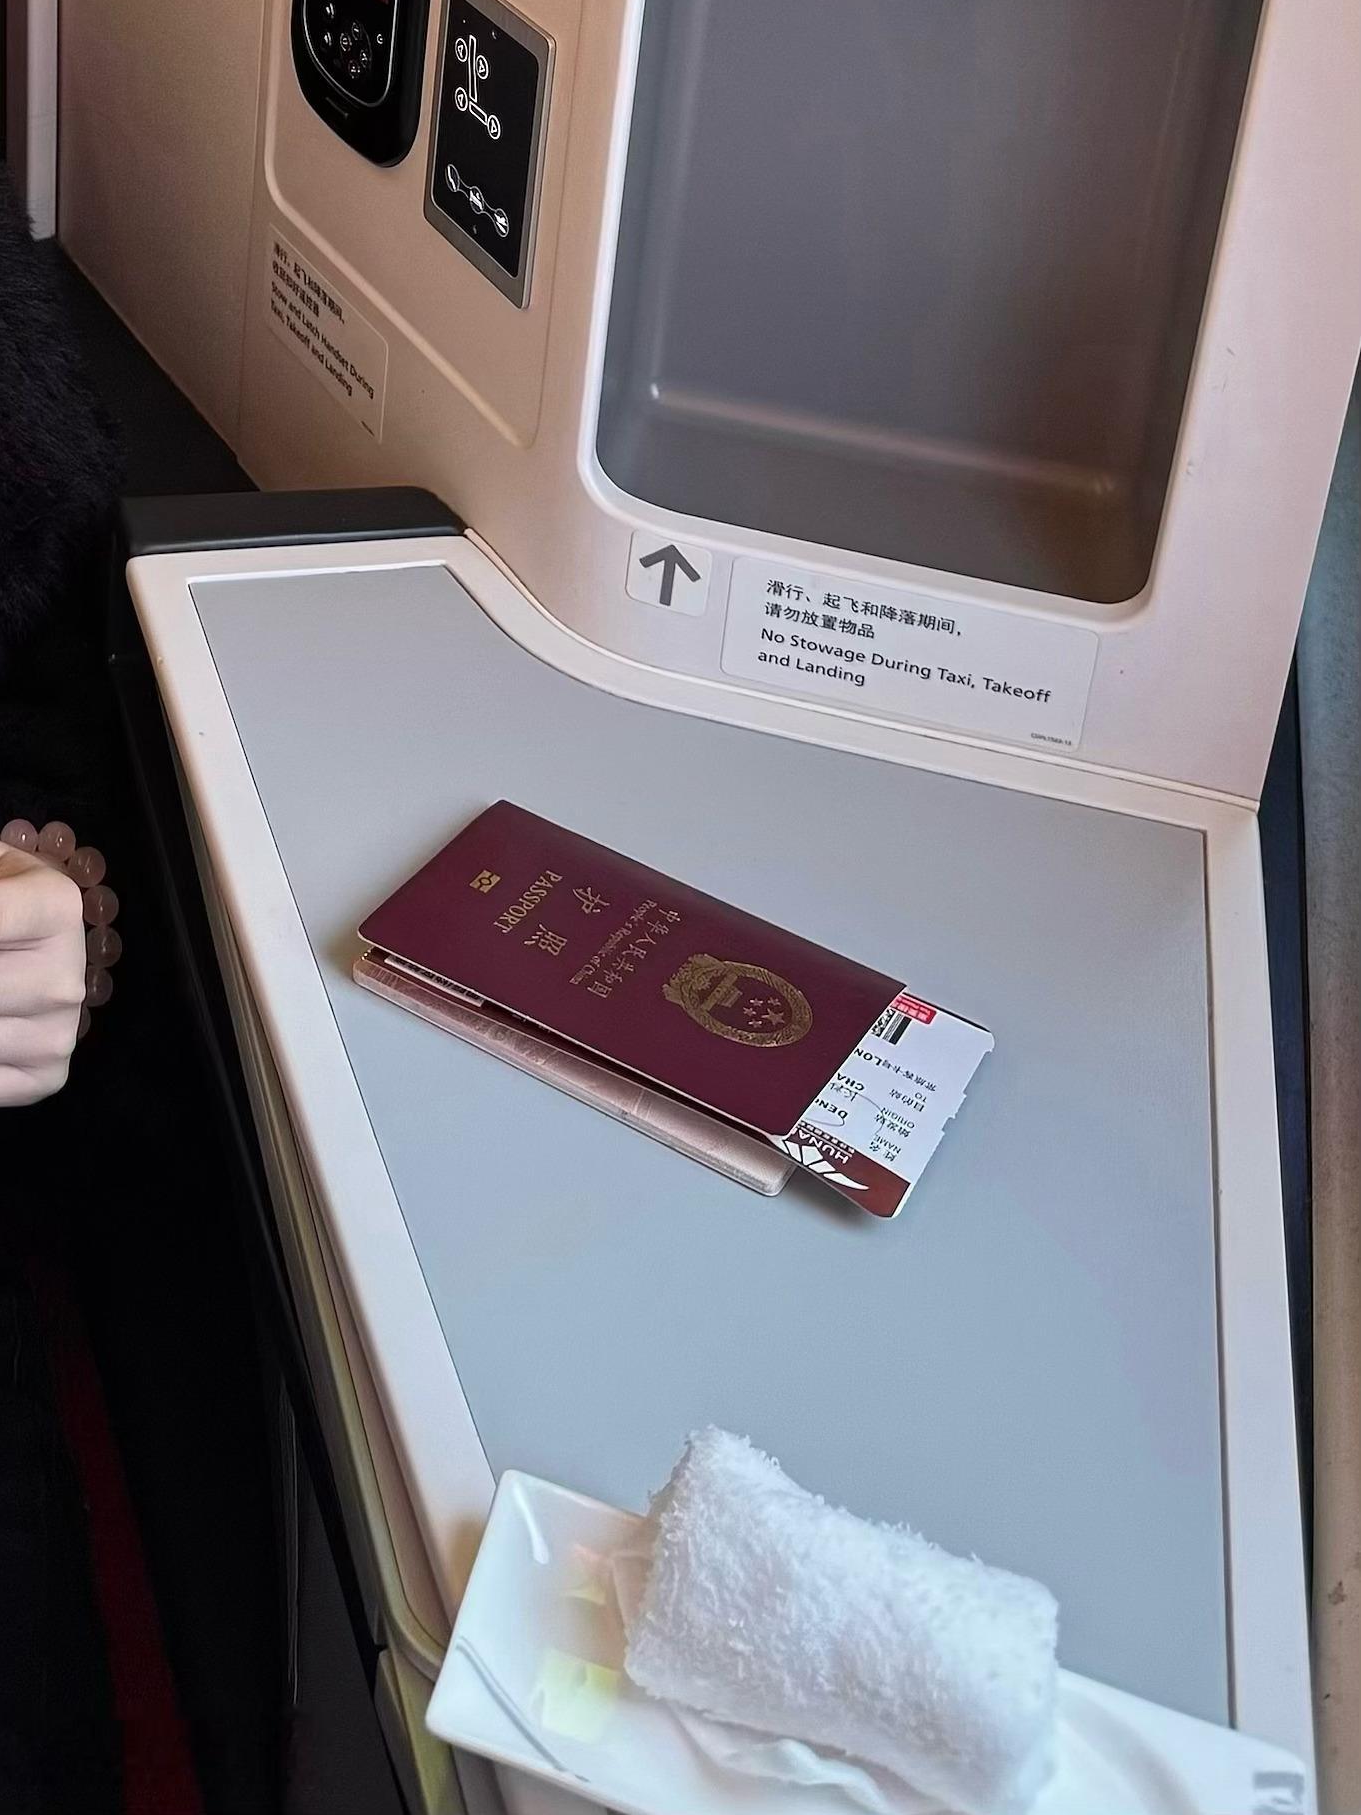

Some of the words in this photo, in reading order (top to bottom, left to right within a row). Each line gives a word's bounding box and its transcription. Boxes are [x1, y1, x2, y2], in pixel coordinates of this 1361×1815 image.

[350, 364, 374, 399] During
[764, 602, 875, 639] 请勿放置物品
[757, 651, 790, 667] and
[795, 658, 866, 687] Landing
[760, 627, 785, 644] No
[790, 634, 866, 664] Stowage
[871, 653, 931, 680] During
[937, 667, 975, 689] Taxi,
[983, 677, 1051, 703] Takeoff
[494, 870, 563, 933] PASSPORT
[625, 899, 657, 929] People's
[587, 908, 681, 998] 中华人民共和国
[598, 927, 632, 958] Republic
[815, 1098, 849, 1119] DEN
